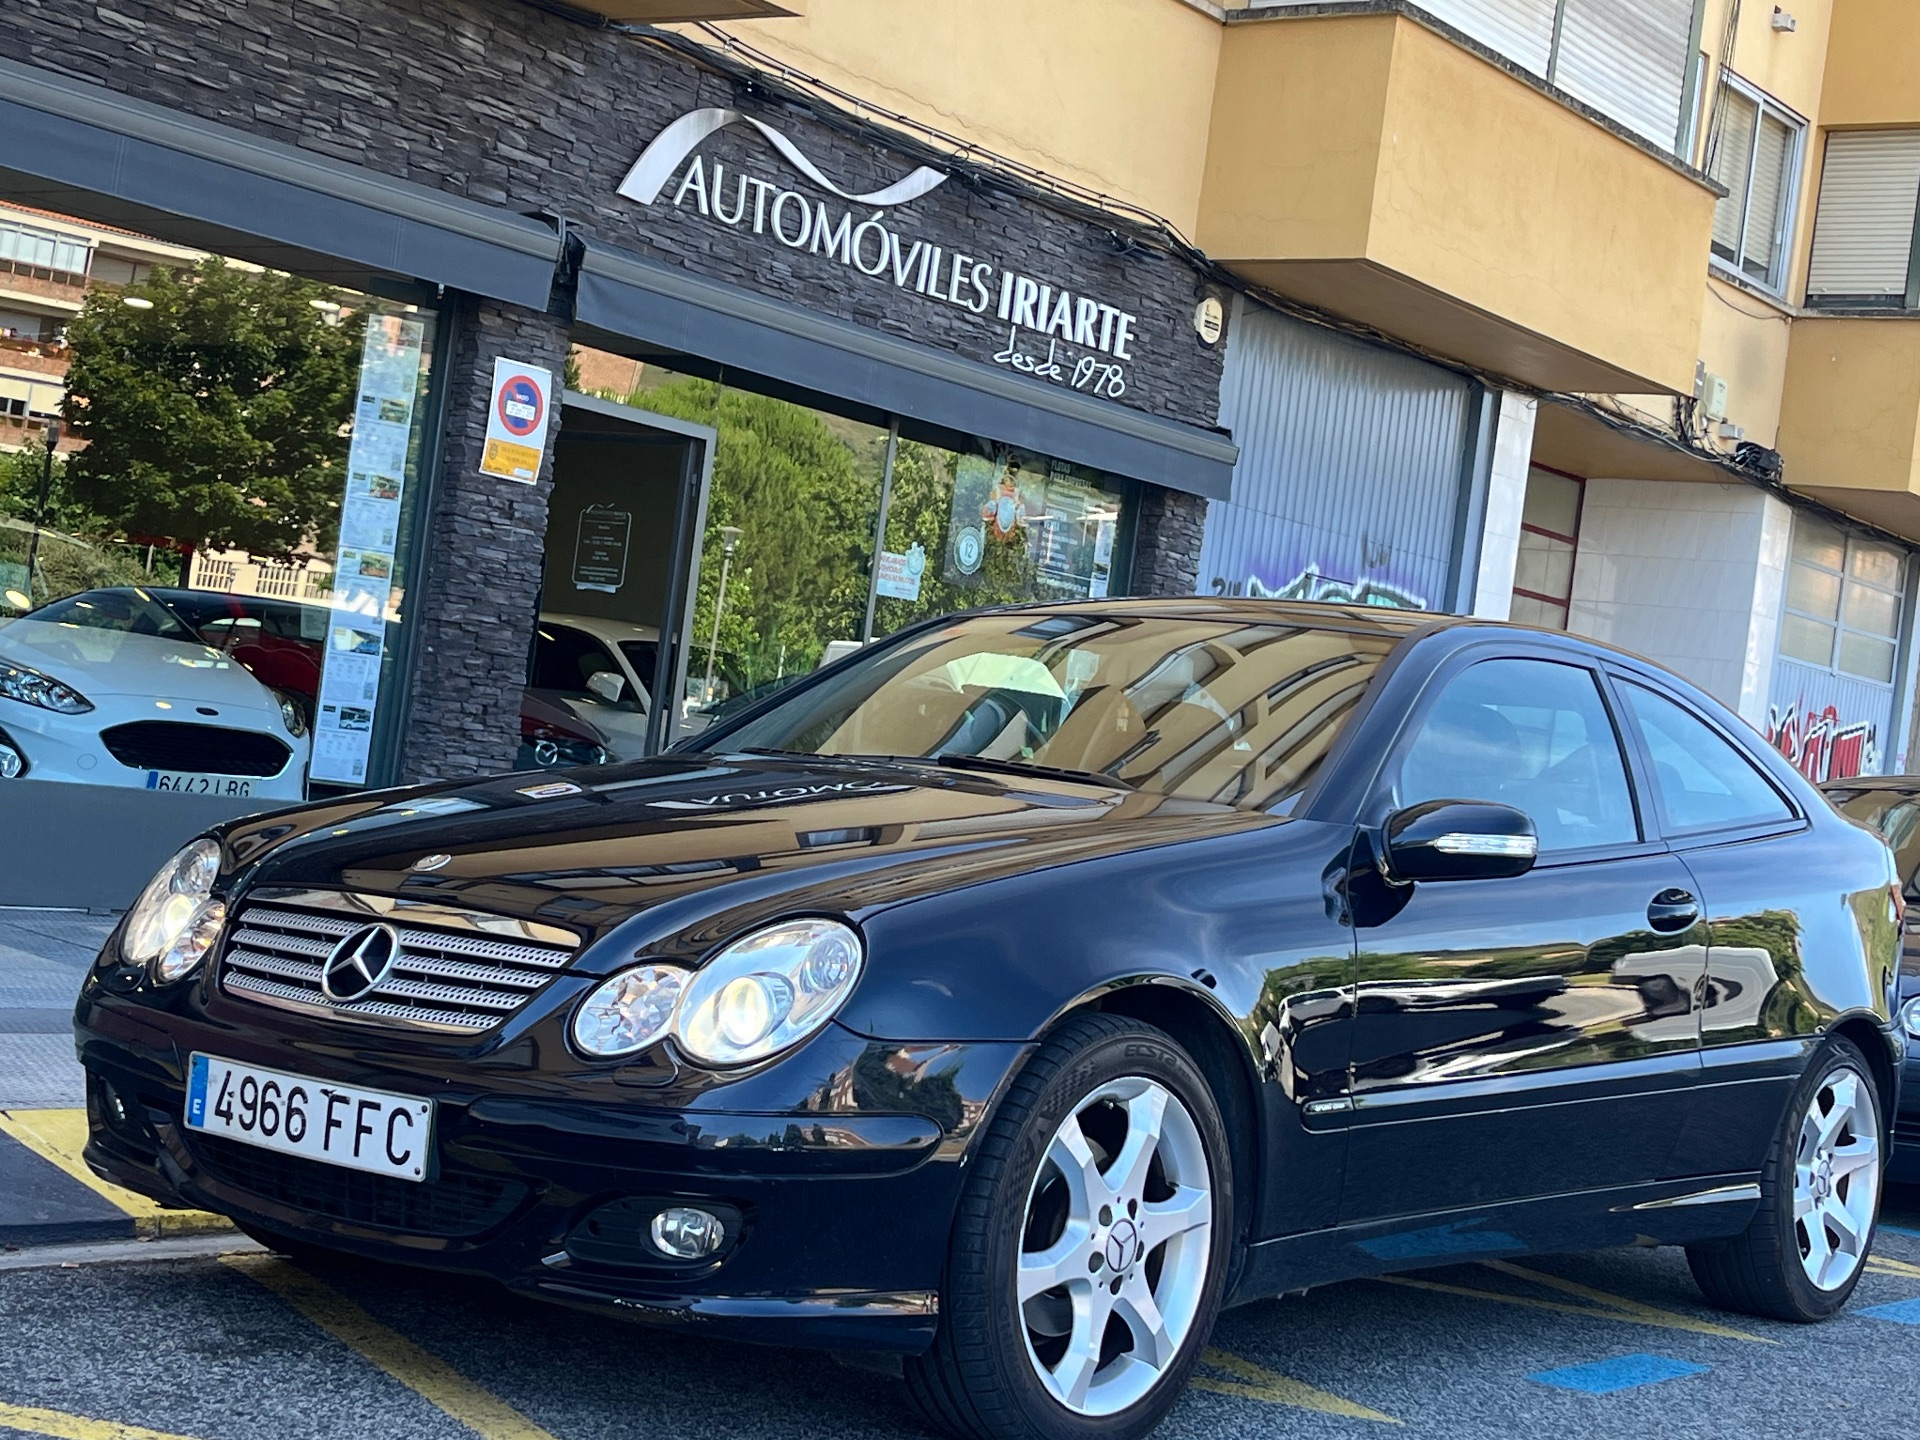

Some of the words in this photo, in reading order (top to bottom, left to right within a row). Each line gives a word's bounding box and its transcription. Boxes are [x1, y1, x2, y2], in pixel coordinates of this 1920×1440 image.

[673, 154, 993, 313] AUTOMÓVILES
[997, 271, 1136, 361] IRIARTE
[993, 325, 1063, 381] desde
[1071, 356, 1126, 397] 1978
[192, 1098, 203, 1114] E
[214, 1070, 309, 1143] 4966
[321, 1090, 413, 1166] FFC
